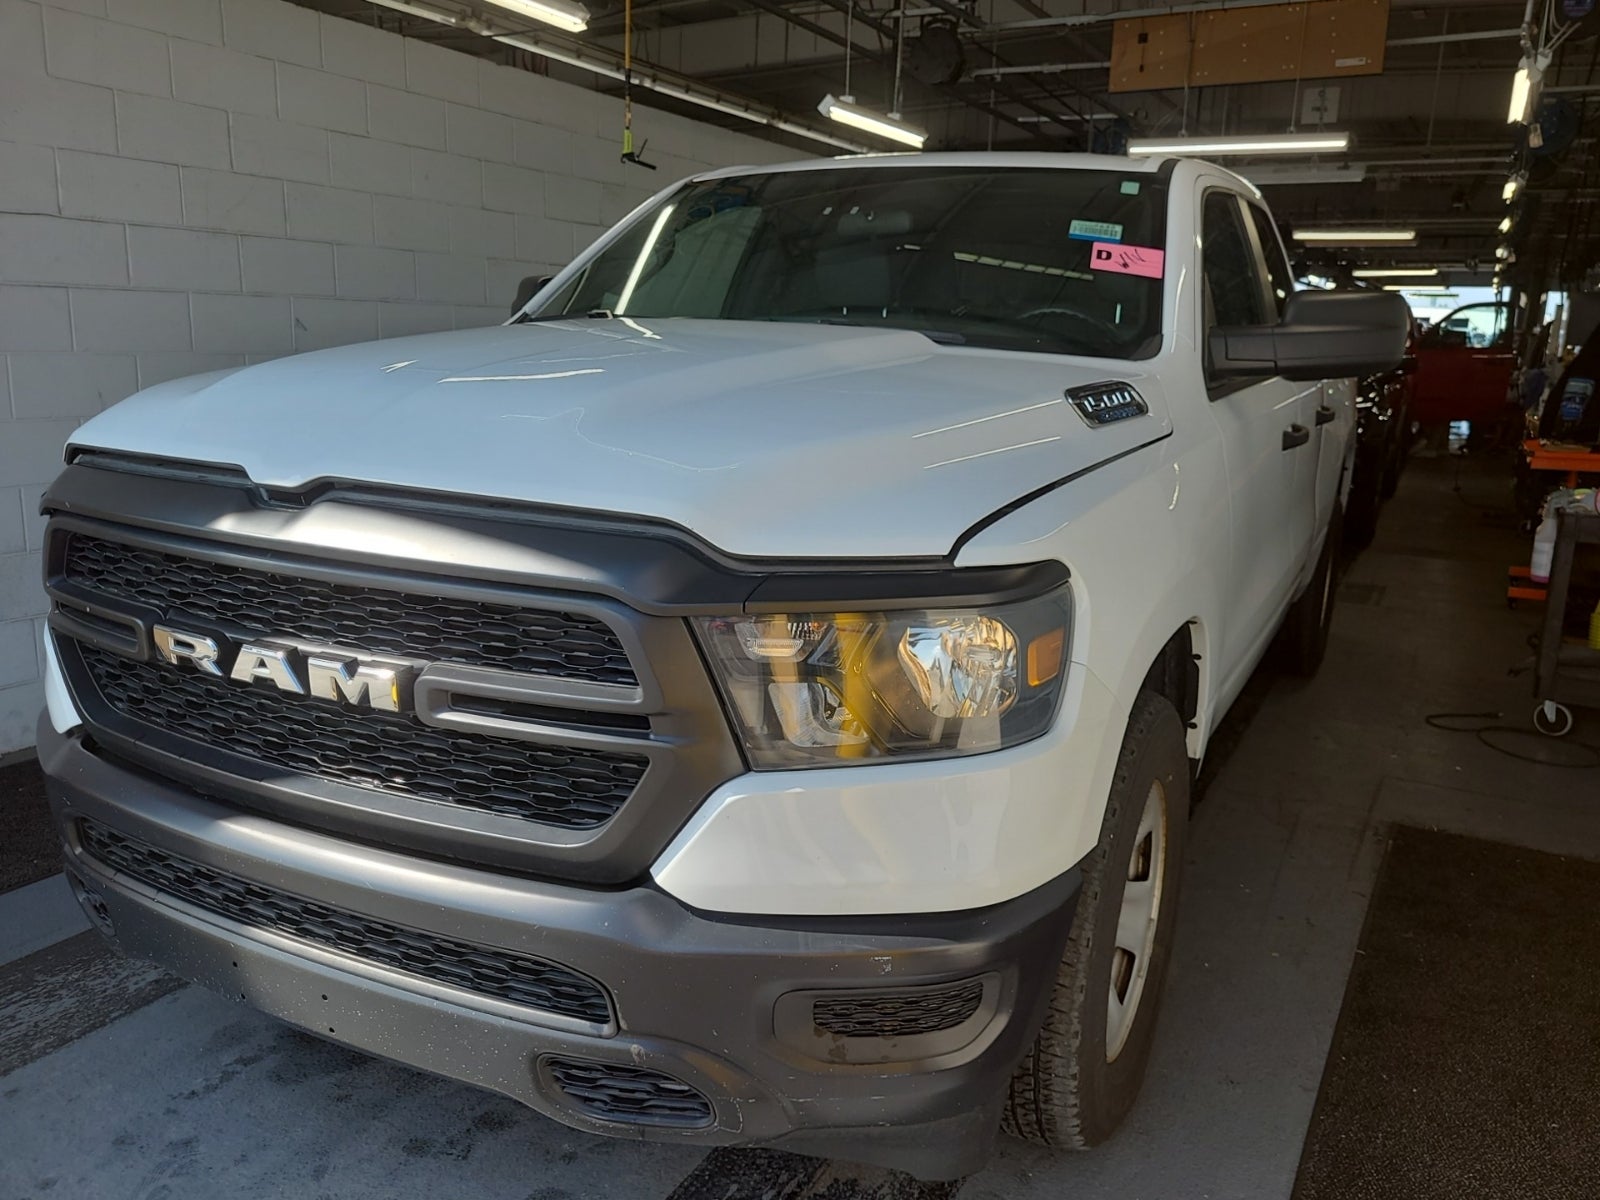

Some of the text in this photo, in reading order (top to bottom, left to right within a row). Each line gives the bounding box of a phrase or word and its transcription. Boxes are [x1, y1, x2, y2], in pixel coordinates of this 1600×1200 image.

[1096, 249, 1112, 261] D
[1083, 389, 1132, 412] 1500
[153, 624, 399, 712] RAM
